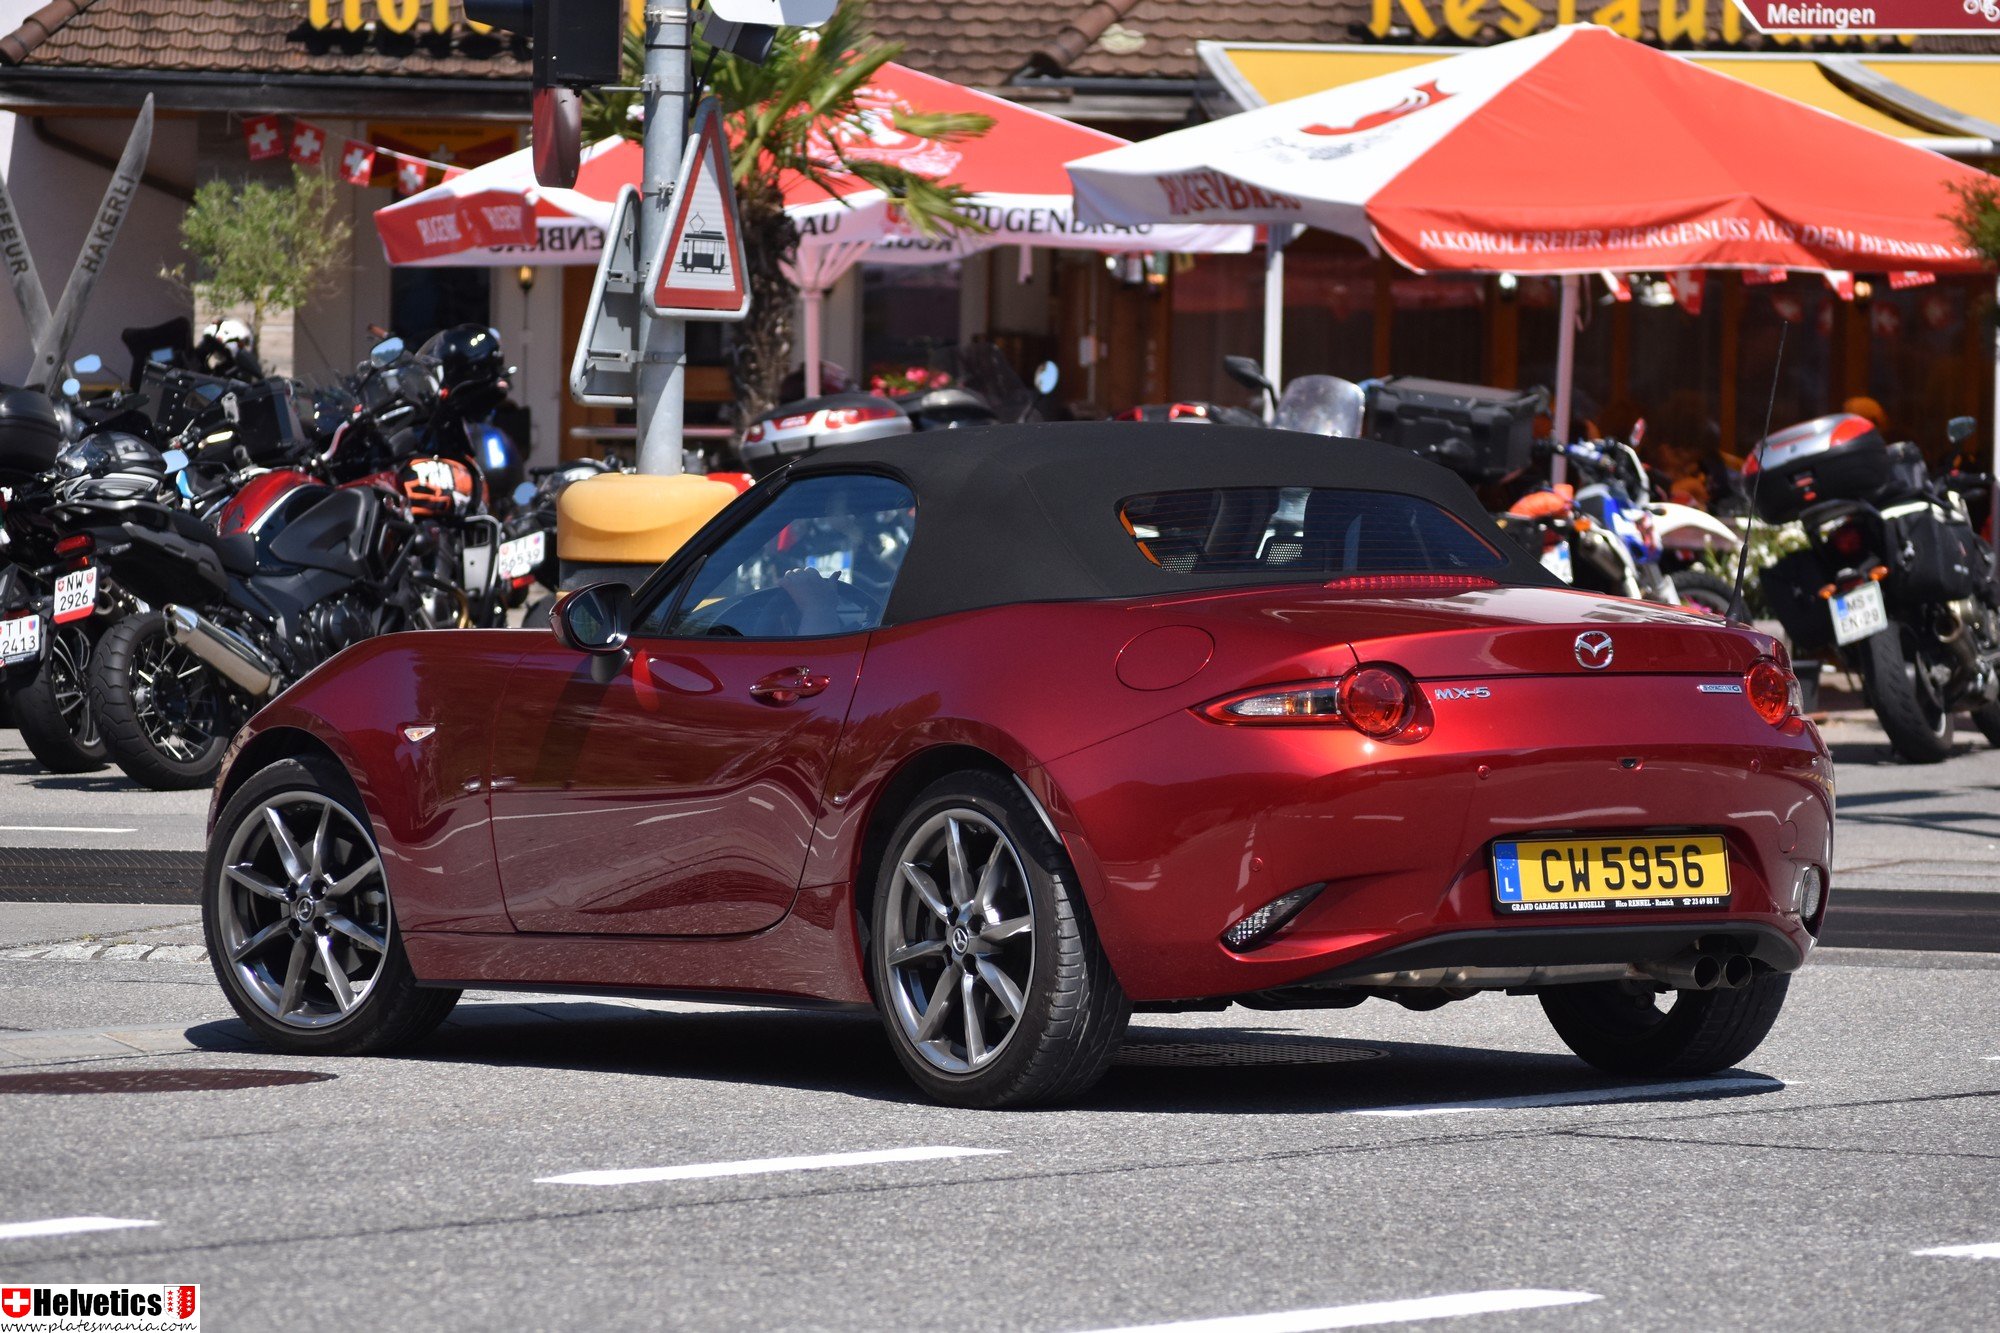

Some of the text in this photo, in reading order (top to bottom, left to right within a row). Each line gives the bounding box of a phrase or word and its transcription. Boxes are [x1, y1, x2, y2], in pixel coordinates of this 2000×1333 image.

[1767, 3, 1876, 29] Meiringen
[1419, 229, 1602, 254] ALKOHOLFREIER
[1607, 217, 1751, 249] BIERGENUSS
[1754, 218, 1798, 242] AUS
[1802, 225, 1854, 251] DEM
[66, 573, 84, 592] NW
[60, 589, 89, 611] 2926
[1435, 686, 1491, 700] MX-5
[1541, 844, 1705, 893] CW 5956
[1504, 877, 1514, 893] L
[1511, 903, 1534, 911] GRAND
[1534, 902, 1559, 910] GARAGE
[1560, 902, 1568, 910] DE
[1578, 900, 1605, 909] MOSELLE
